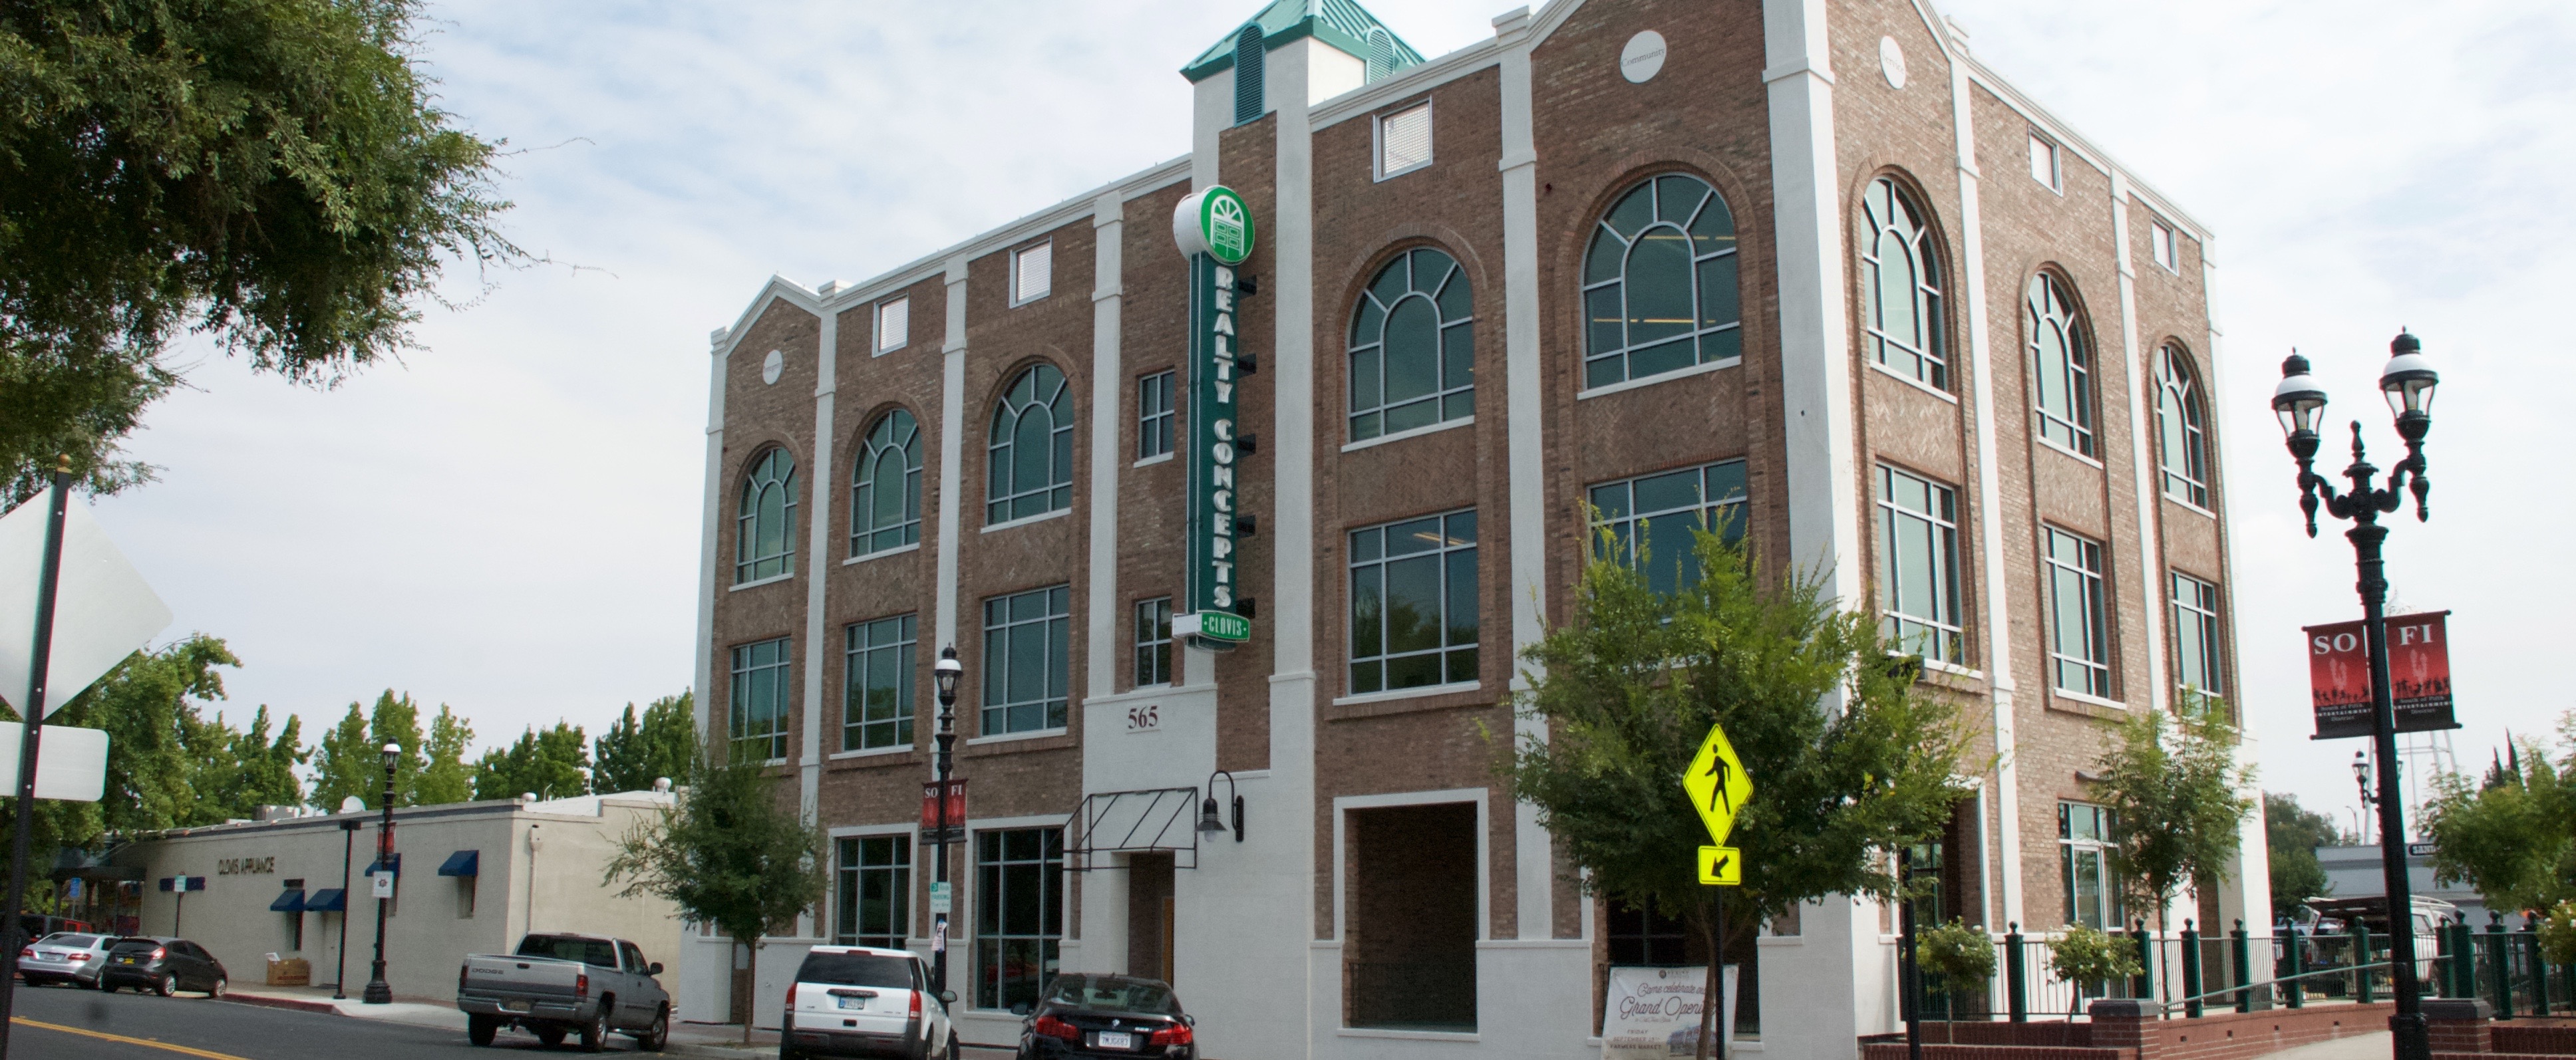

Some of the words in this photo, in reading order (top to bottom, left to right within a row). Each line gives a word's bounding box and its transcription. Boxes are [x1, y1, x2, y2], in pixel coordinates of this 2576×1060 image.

[1621, 48, 1665, 67] Community
[1213, 265, 1235, 404] REALTY
[1212, 418, 1233, 608] CONCEPTS
[1209, 616, 1243, 636] CLOVIS
[2398, 624, 2434, 646] FI
[2314, 633, 2357, 655] SO
[1128, 706, 1158, 729] 565
[925, 787, 939, 798] SO
[951, 785, 963, 796] FI
[218, 858, 239, 875] CLOVIS
[240, 857, 275, 874] APPLIANCE
[1637, 983, 1662, 997] Come
[1663, 982, 1696, 994] celebrate
[1620, 996, 1663, 1019] Grand
[1665, 995, 1715, 1021] Openi
